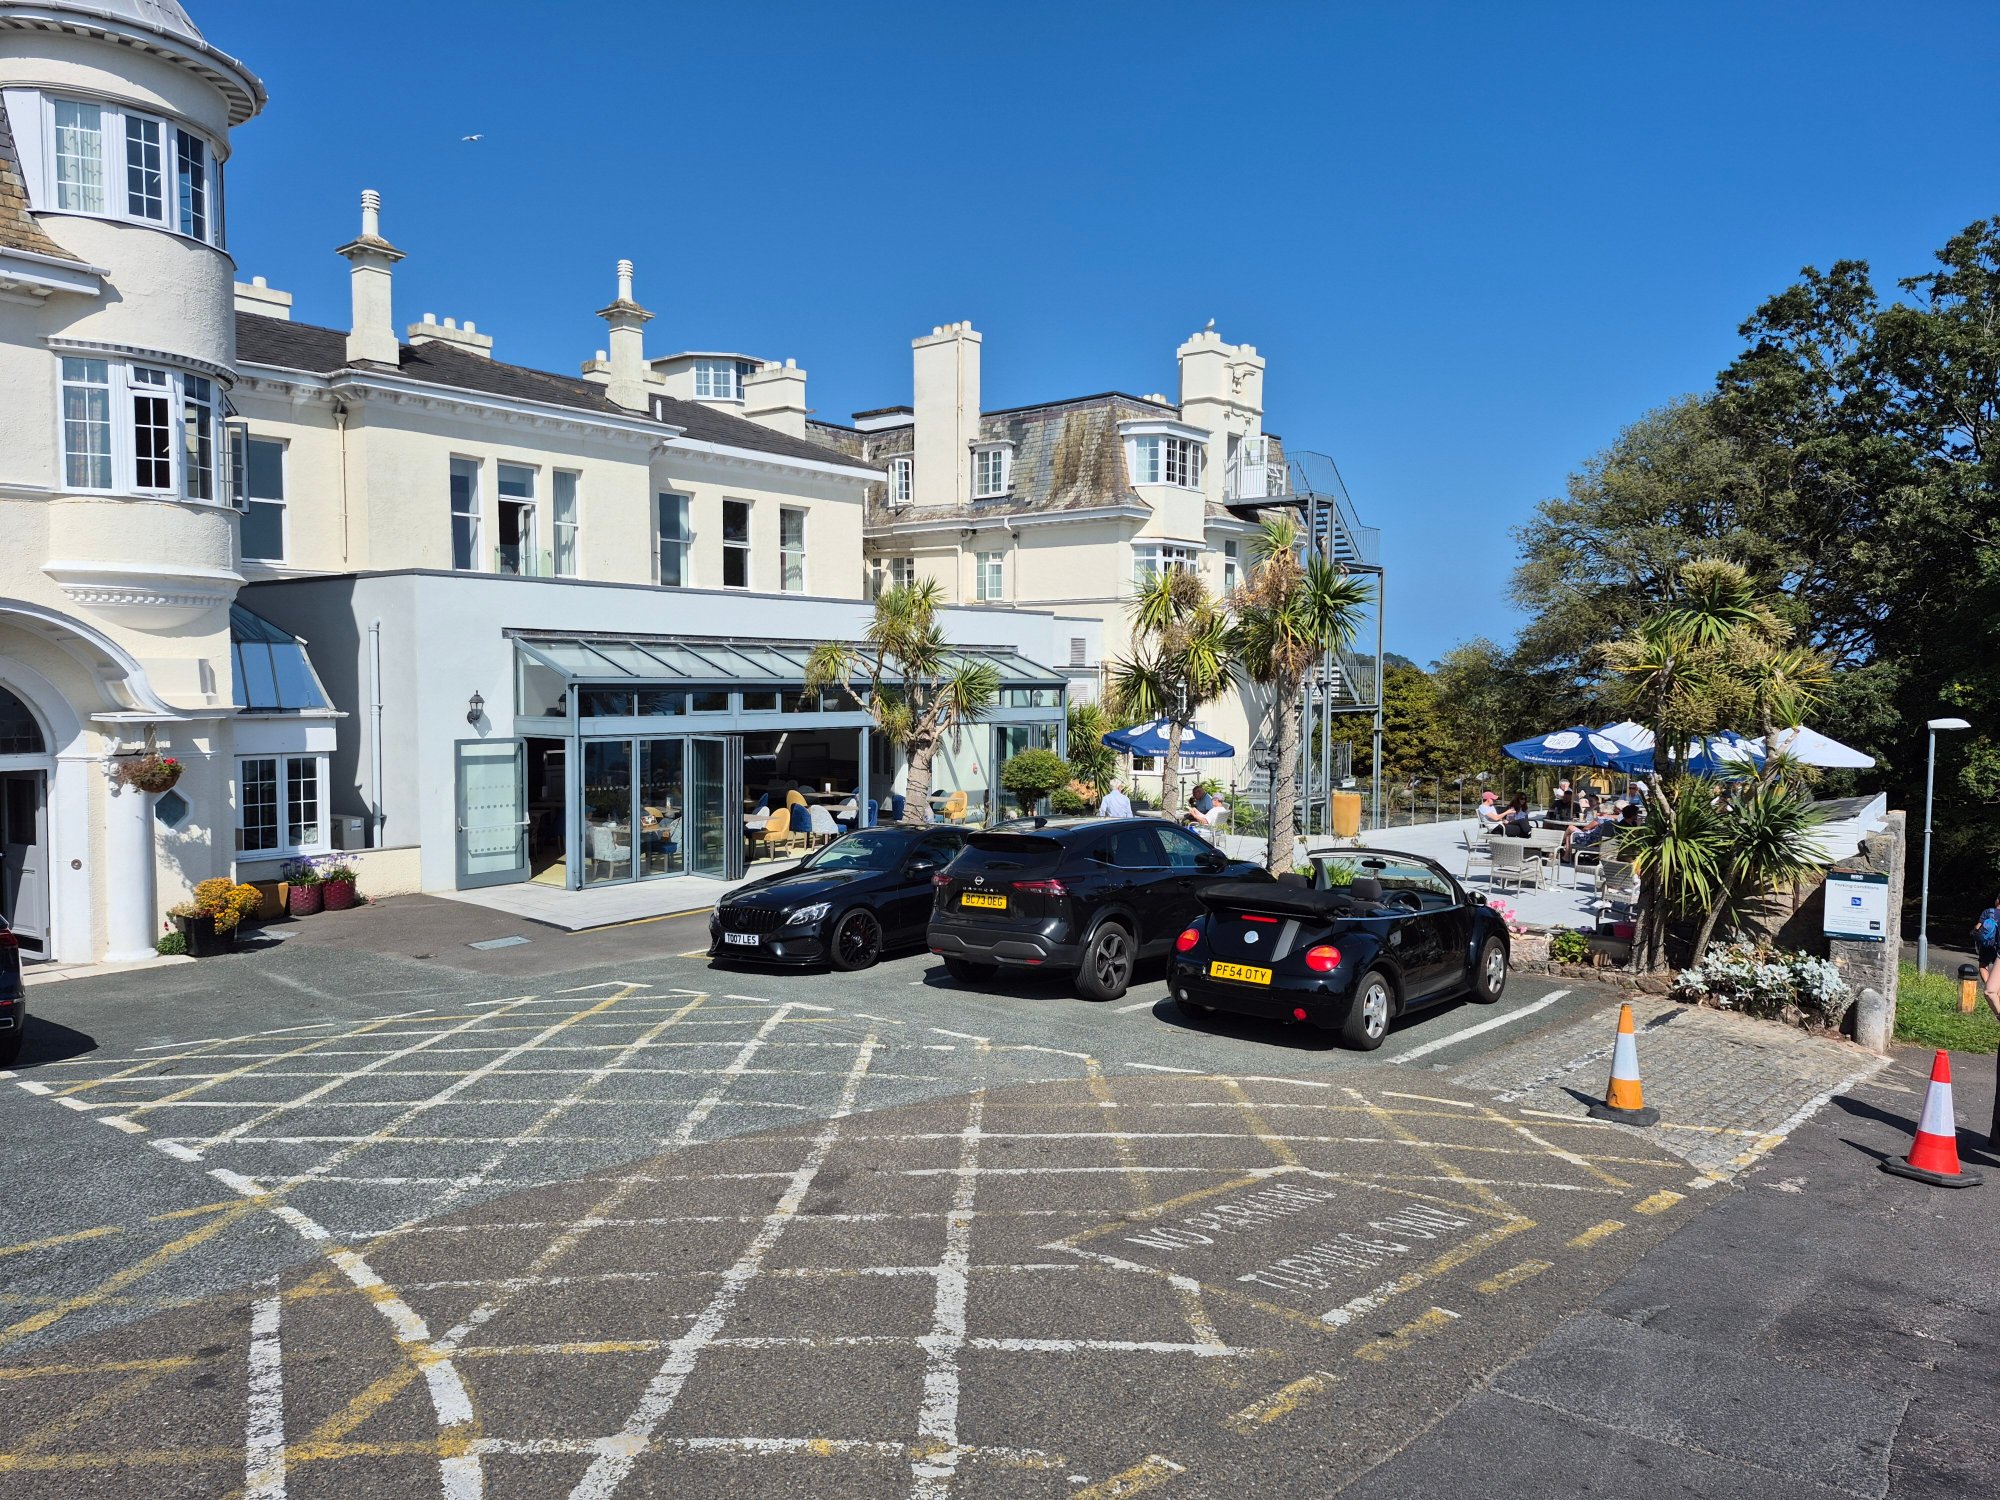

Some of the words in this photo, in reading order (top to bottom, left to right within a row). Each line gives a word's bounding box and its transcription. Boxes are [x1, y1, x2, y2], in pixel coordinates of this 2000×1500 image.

[965, 894, 985, 904] BC73
[743, 935, 757, 944] LES
[1216, 964, 1242, 977] PF54
